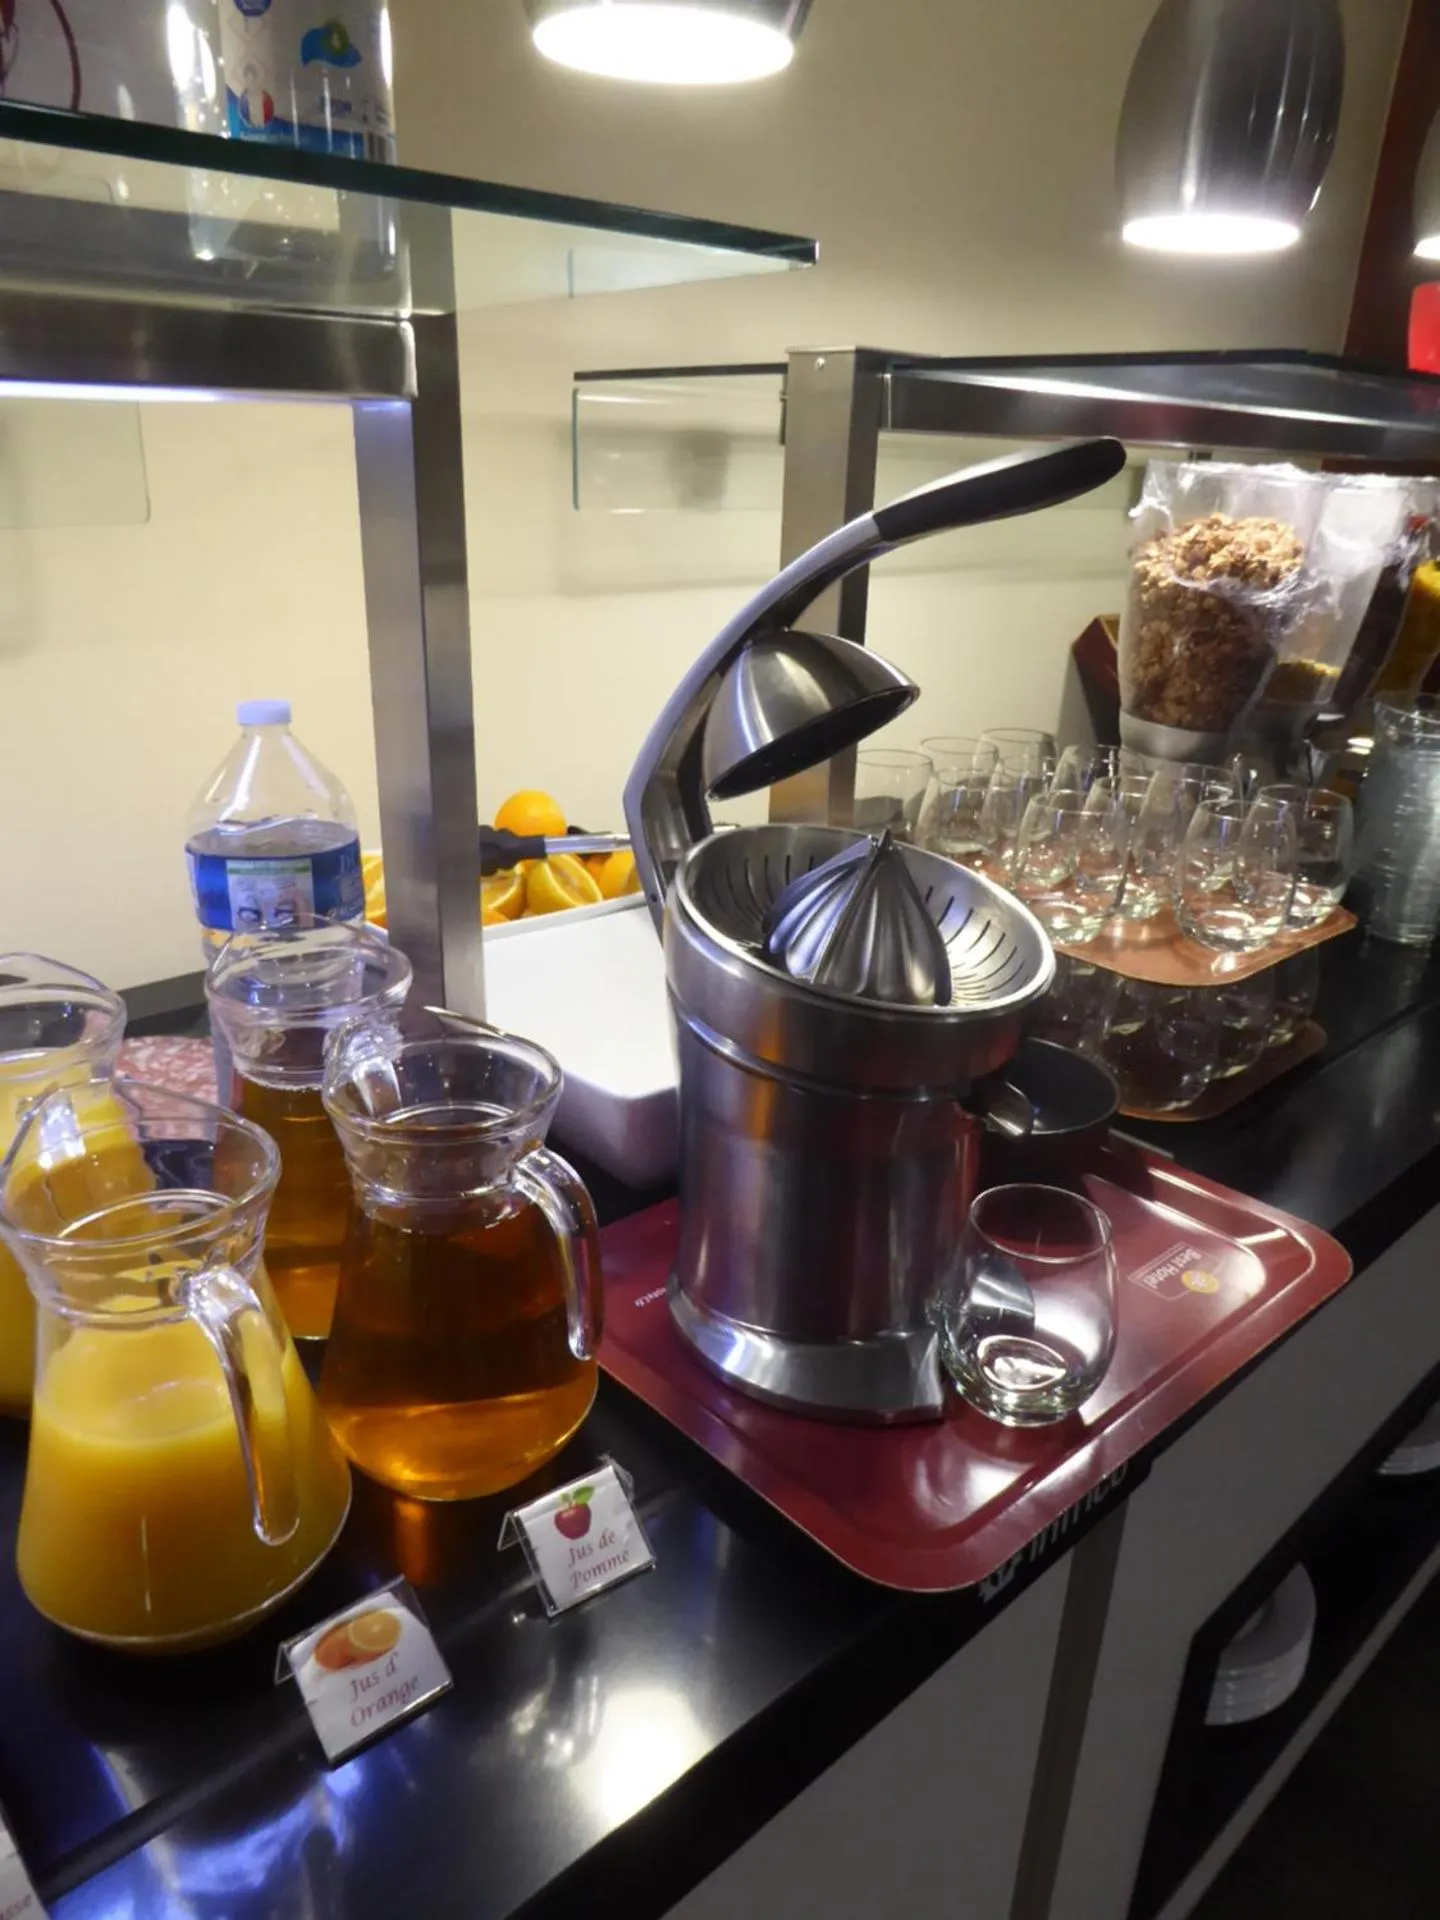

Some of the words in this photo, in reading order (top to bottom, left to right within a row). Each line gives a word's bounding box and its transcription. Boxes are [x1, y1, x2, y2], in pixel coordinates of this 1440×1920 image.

[568, 1543, 595, 1568] Jus
[599, 1529, 616, 1549] de
[570, 1549, 630, 1589] Pomme
[349, 1672, 380, 1700] Jus
[350, 1676, 421, 1727] Orange
